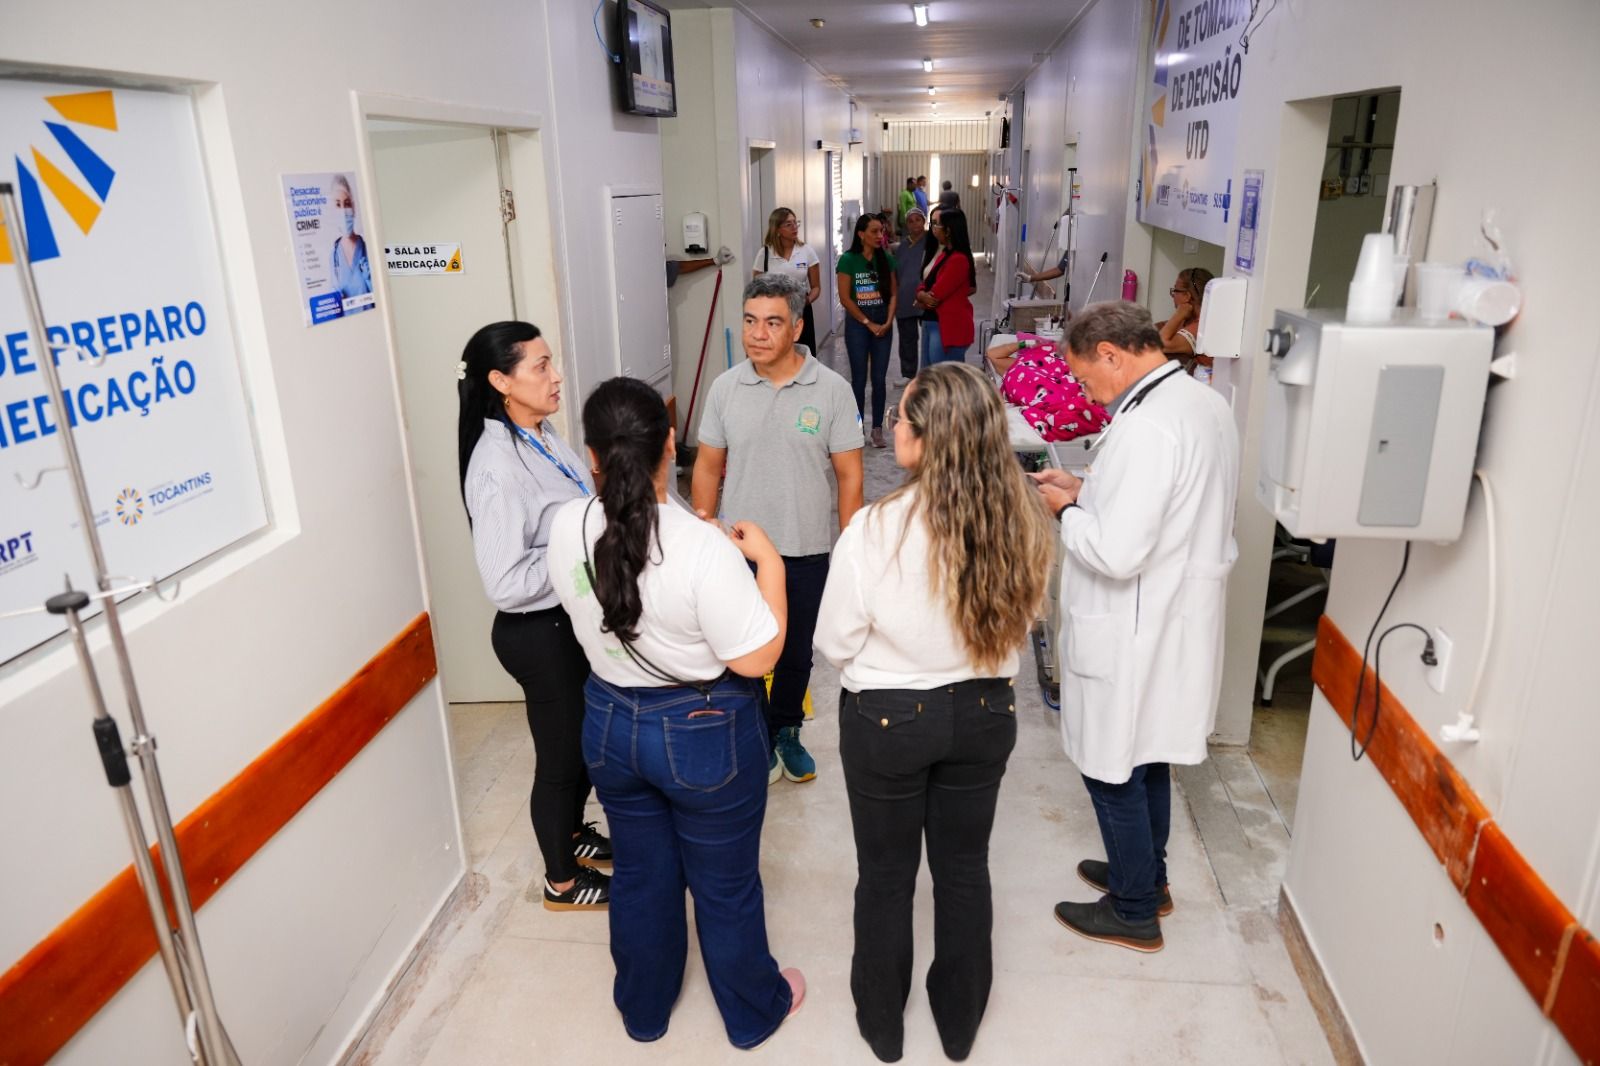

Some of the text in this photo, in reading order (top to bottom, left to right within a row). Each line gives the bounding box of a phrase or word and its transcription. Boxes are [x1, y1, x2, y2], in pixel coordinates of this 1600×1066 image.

[1178, 10, 1193, 51] DE
[1171, 44, 1242, 113] DE DECISÃO
[1186, 119, 1209, 161] UTD
[387, 259, 447, 270] MEDICAÇÃO
[394, 246, 437, 255] SALA DE
[0, 300, 207, 379] E PREPARO
[0, 355, 196, 449] EDICAÇÃO
[148, 471, 213, 507] TOCANTINS
